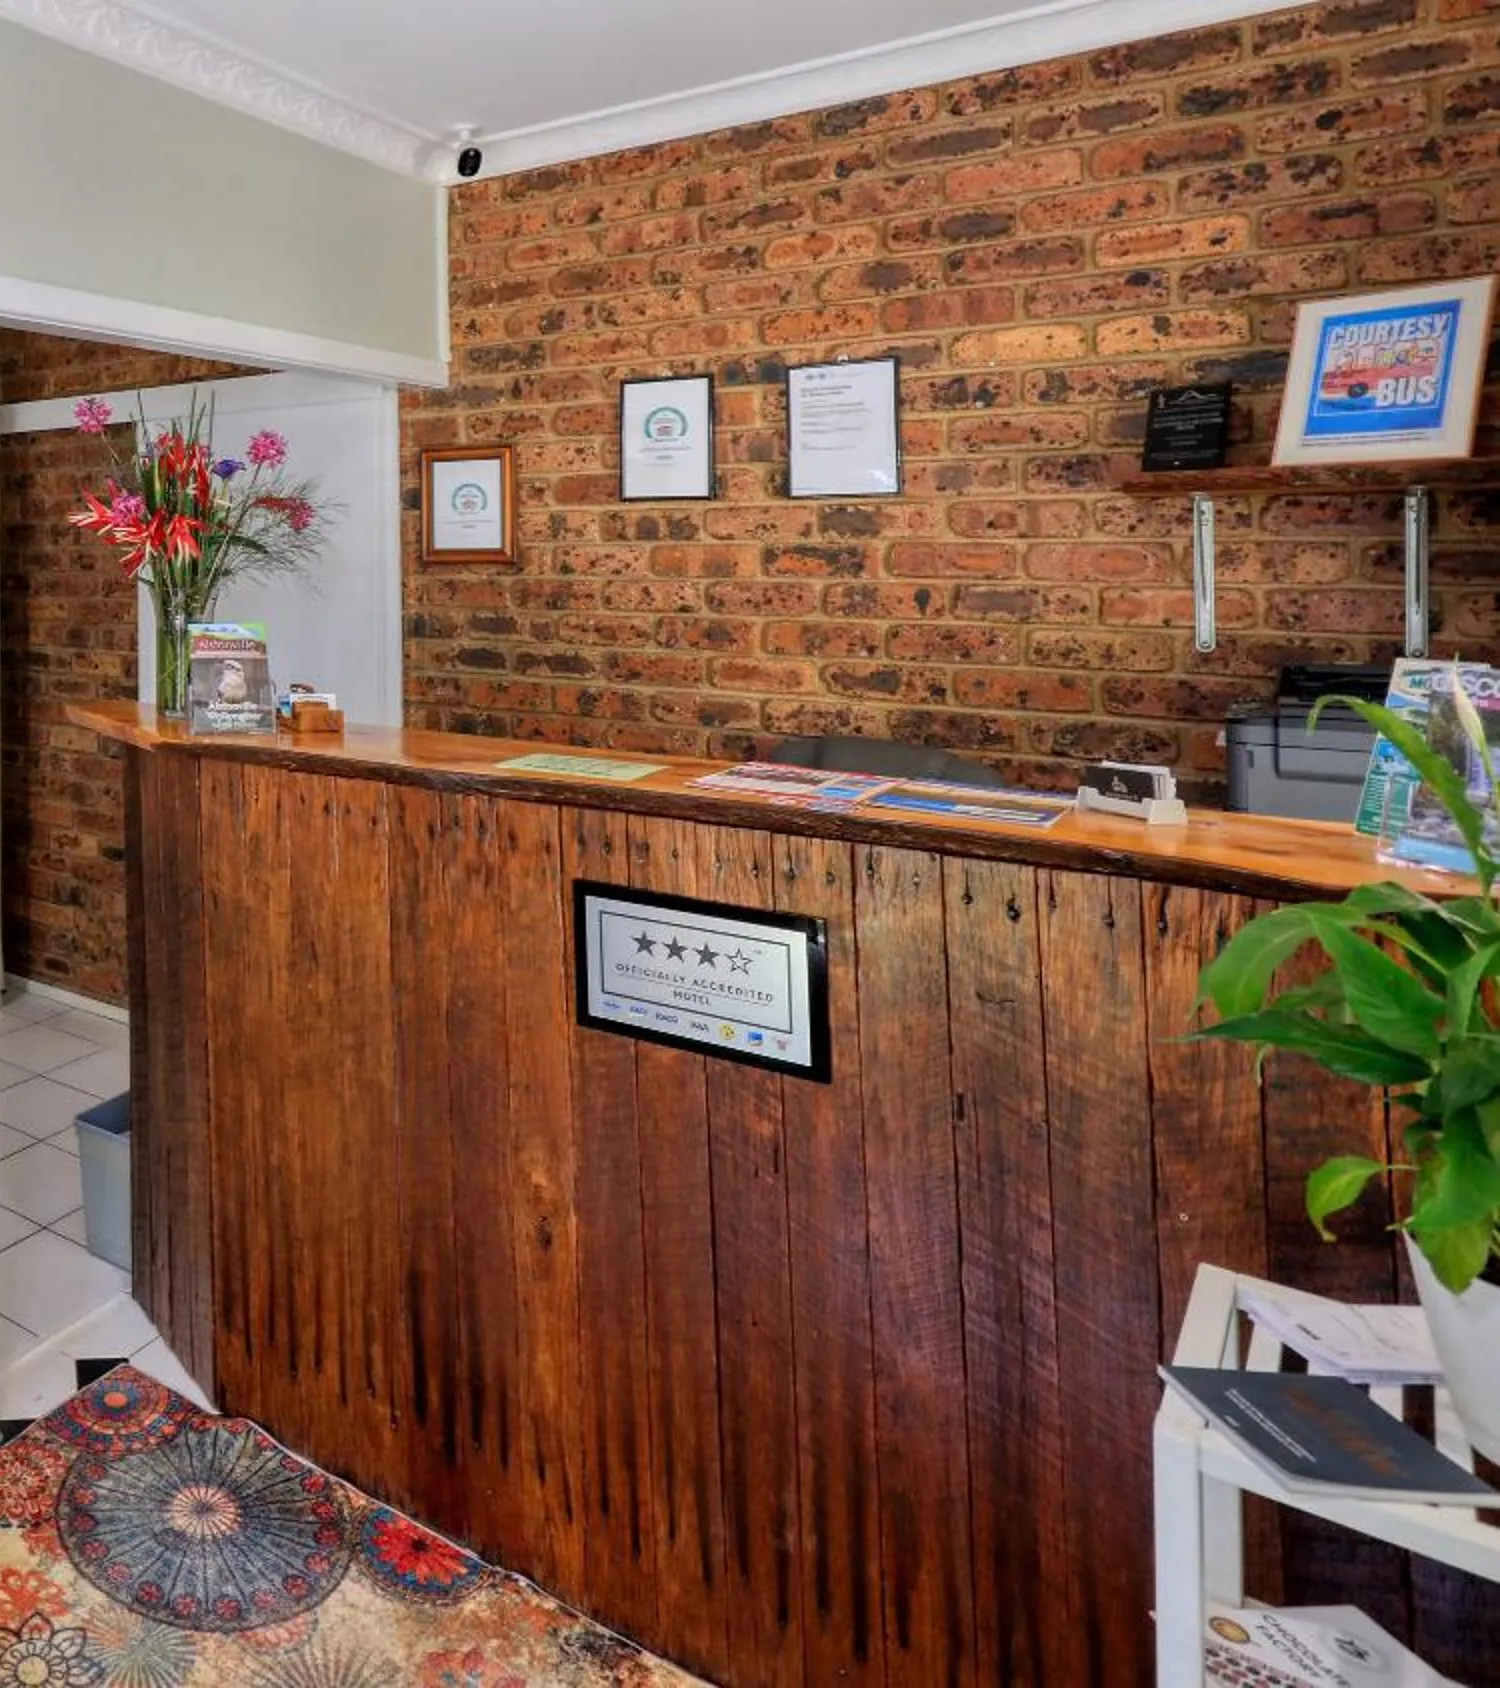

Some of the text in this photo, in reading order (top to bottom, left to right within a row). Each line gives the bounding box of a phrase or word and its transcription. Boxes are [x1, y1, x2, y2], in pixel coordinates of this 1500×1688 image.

[1331, 312, 1451, 350] COURTESY
[1376, 374, 1438, 407] BUS
[615, 963, 773, 1004] OFFICIALLY ACCREDITED
[673, 989, 710, 1006] MOTEL
